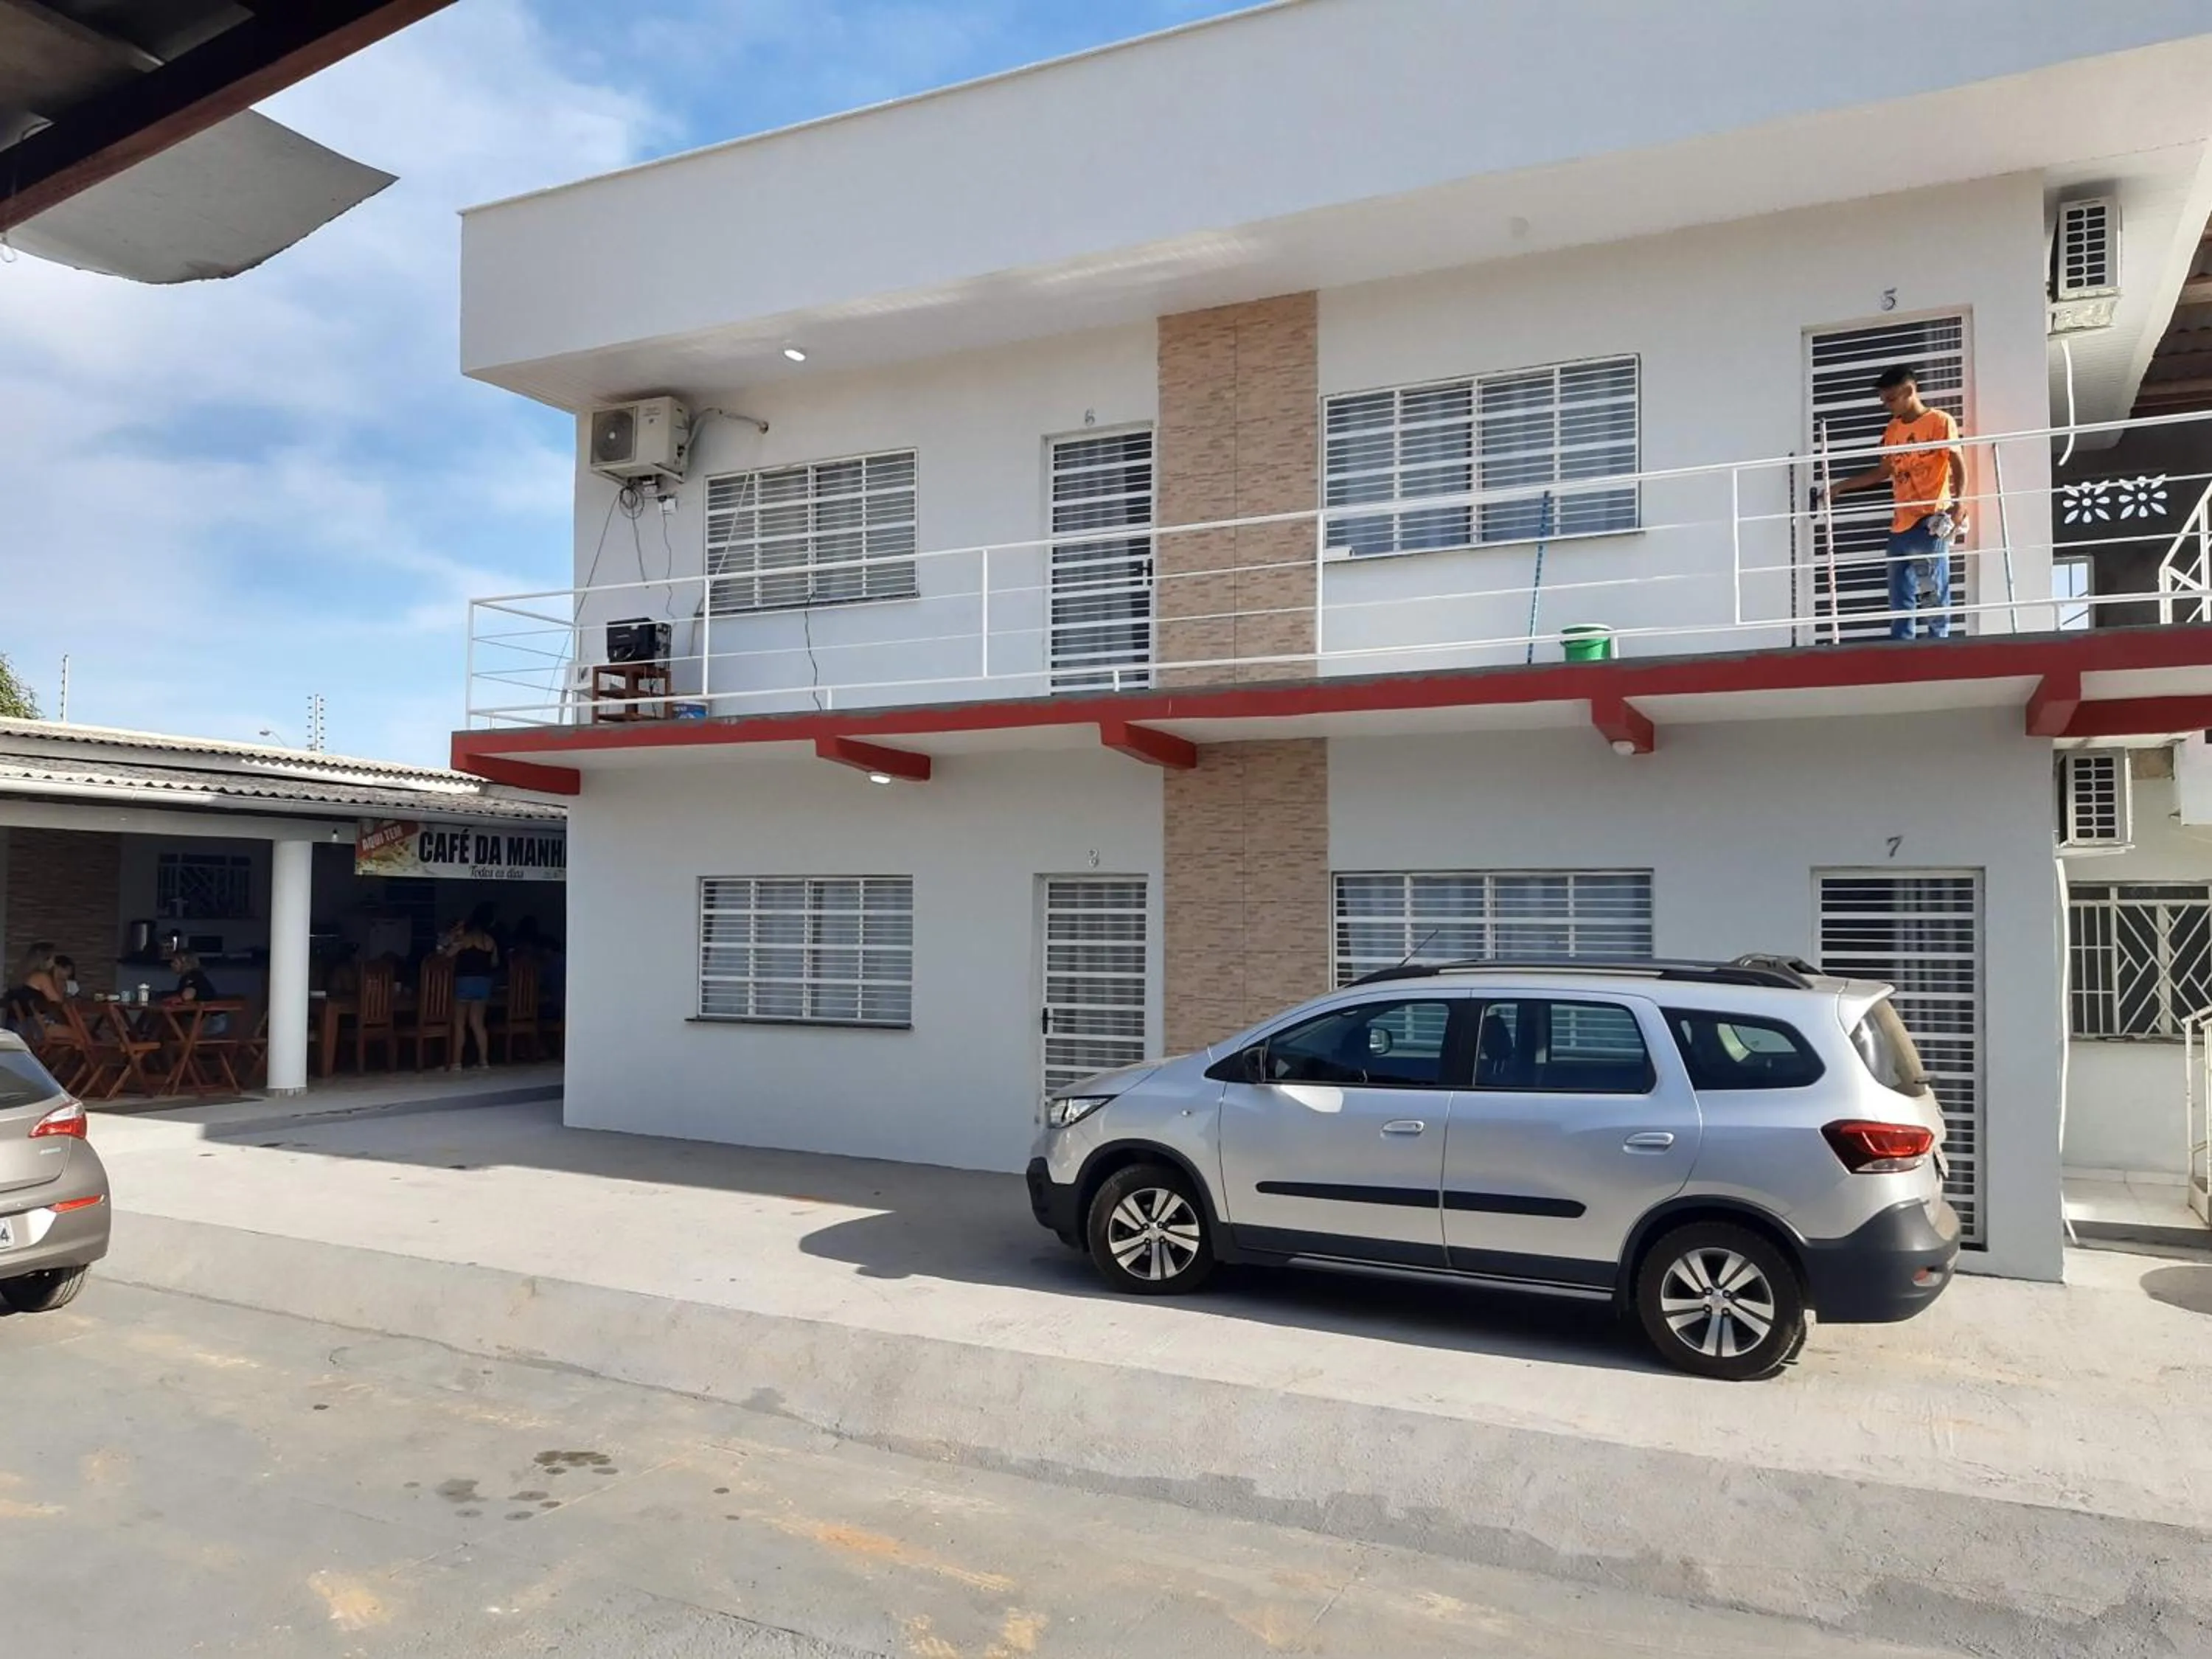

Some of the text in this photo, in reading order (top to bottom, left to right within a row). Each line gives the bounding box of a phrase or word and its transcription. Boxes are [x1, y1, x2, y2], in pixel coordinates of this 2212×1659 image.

[1881, 288, 1897, 310] 5
[1085, 407, 1095, 426] 6
[362, 825, 403, 851] AQUI TEM
[418, 829, 566, 868] CAFÉ DA MANH
[1887, 835, 1903, 858] 7
